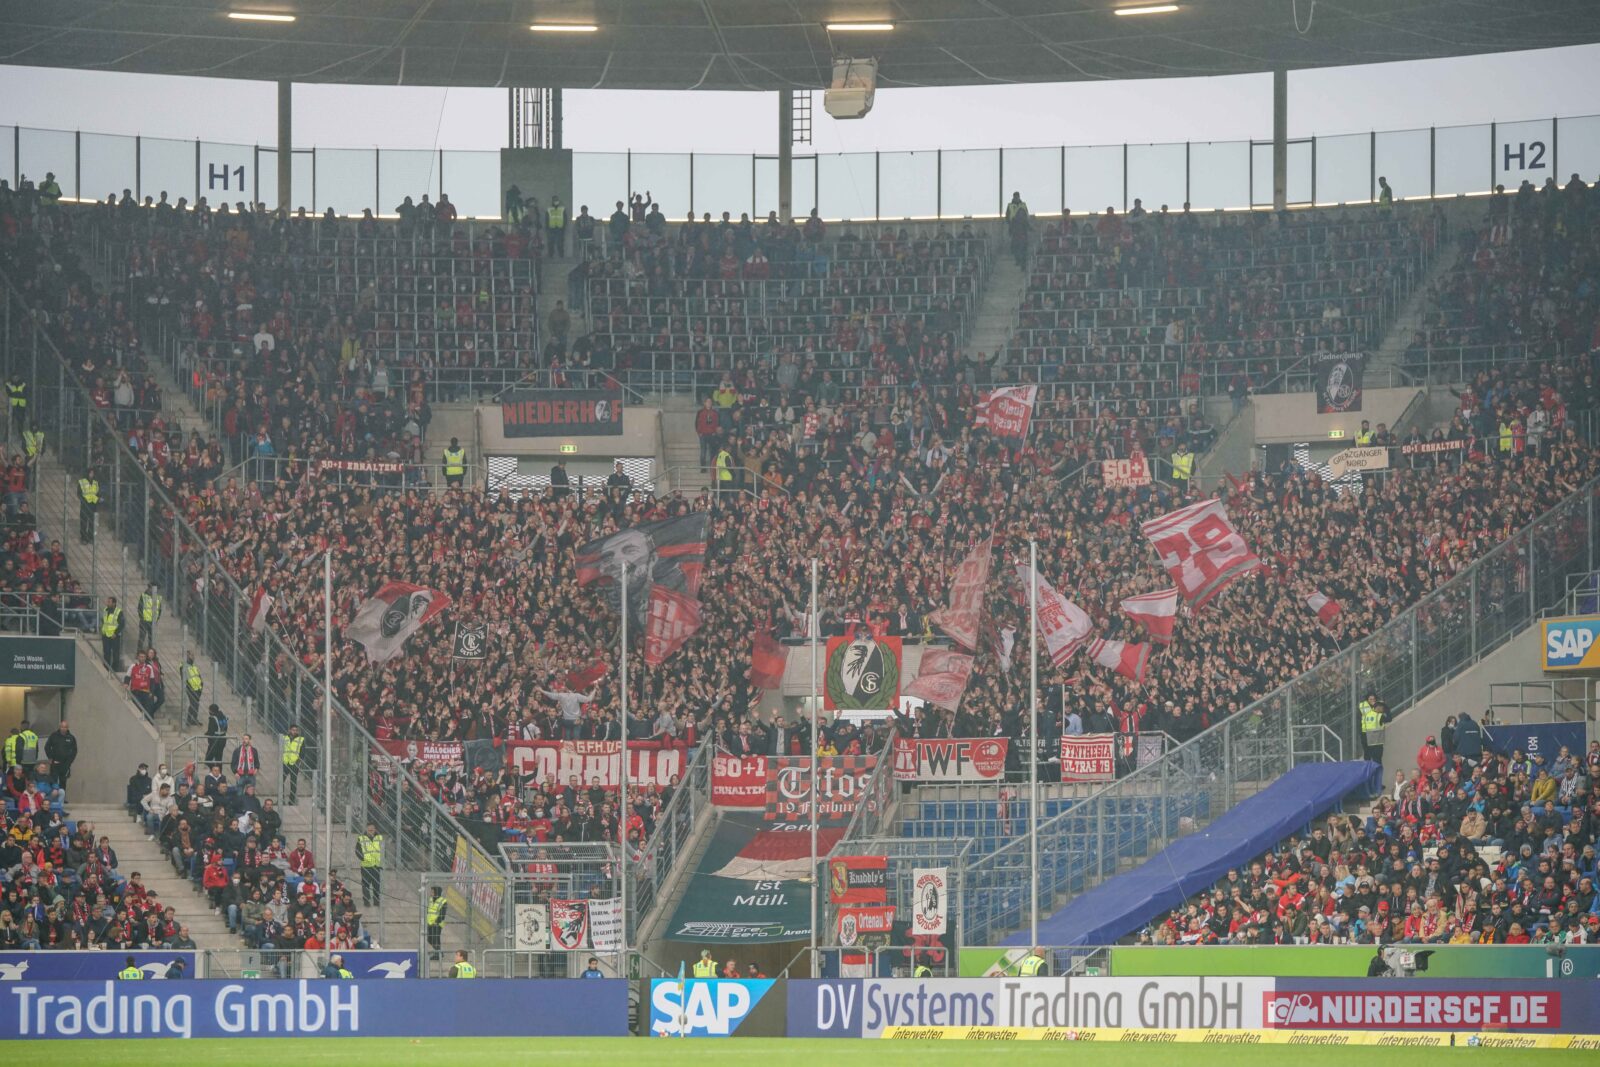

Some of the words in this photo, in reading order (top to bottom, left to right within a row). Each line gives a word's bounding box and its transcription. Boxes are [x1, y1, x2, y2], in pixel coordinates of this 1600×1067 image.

[1504, 141, 1546, 171] H2
[209, 163, 245, 192] H1
[1547, 628, 1593, 659] SAP
[423, 746, 461, 754] MALOCHER
[1061, 744, 1112, 759] SYNTHESIA
[513, 747, 680, 786] CORRILLO
[916, 742, 971, 776] IWF
[1063, 760, 1097, 773] ULTRAS
[1099, 759, 1110, 773] 79
[713, 757, 766, 778] 50+1
[713, 784, 767, 795] ERHALTEN
[777, 803, 796, 814] 19
[754, 880, 782, 891] ist
[733, 894, 788, 906] Müll.
[859, 912, 884, 929] Ortenau
[11, 980, 192, 1039] Trading
[215, 979, 359, 1033] GmbH
[652, 981, 751, 1035] SAP
[816, 983, 857, 1030] DV
[1138, 977, 1243, 1030] GmbH
[1322, 996, 1548, 1024] NURDERSCF.DE
[892, 1027, 944, 1040] interwetten
[965, 1027, 1018, 1040] interwetten
[1120, 1028, 1178, 1043] interwetten
[1200, 1029, 1262, 1044] interwetten
[1288, 1031, 1350, 1045] interwetten
[1378, 1032, 1441, 1046] interwetten
